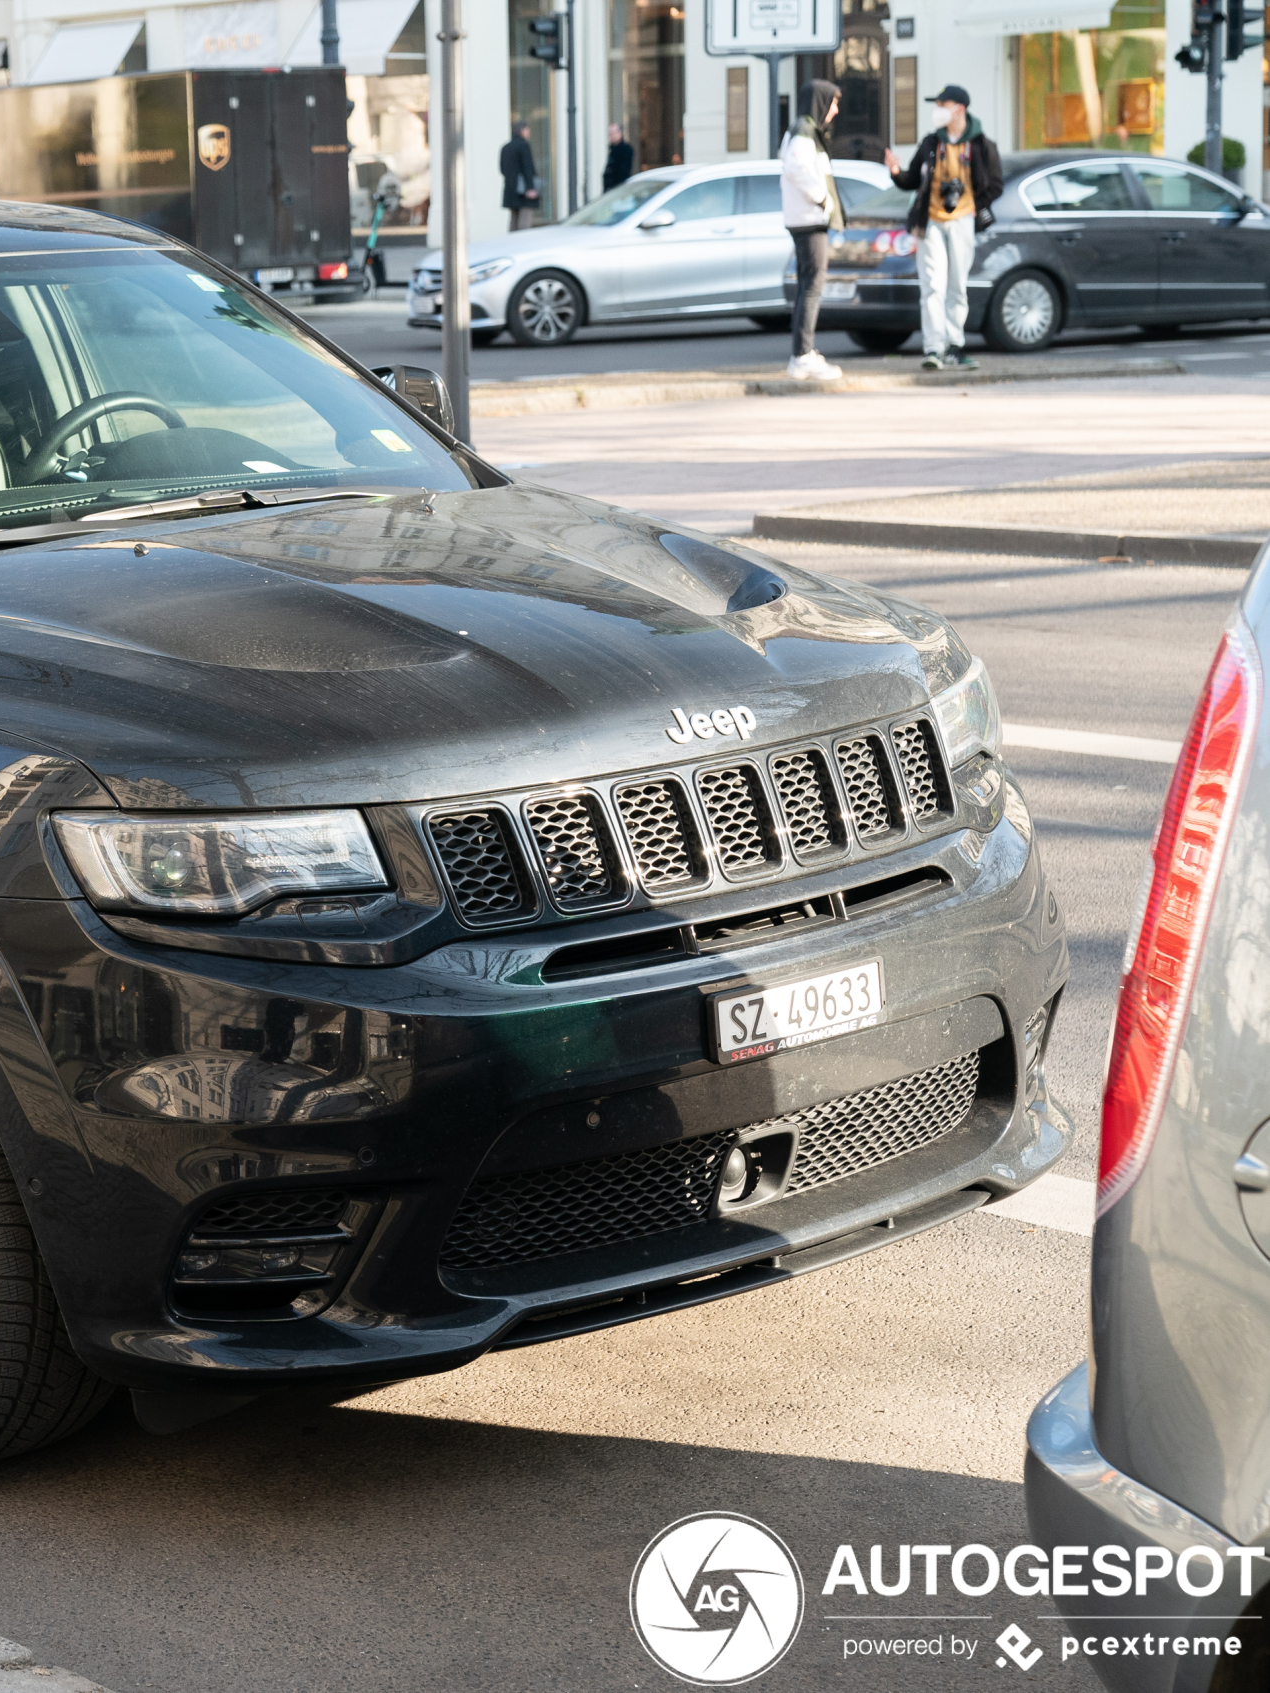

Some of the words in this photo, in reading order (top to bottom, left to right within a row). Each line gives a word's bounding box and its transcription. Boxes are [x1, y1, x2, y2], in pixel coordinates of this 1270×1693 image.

[203, 33, 262, 53] GUCCI
[665, 705, 757, 744] Jeep
[730, 997, 767, 1044] SZ
[787, 972, 871, 1029] 49633
[731, 1041, 775, 1062] SENAG
[777, 1019, 858, 1050] AUTOMOBILE
[858, 1014, 878, 1030] AG
